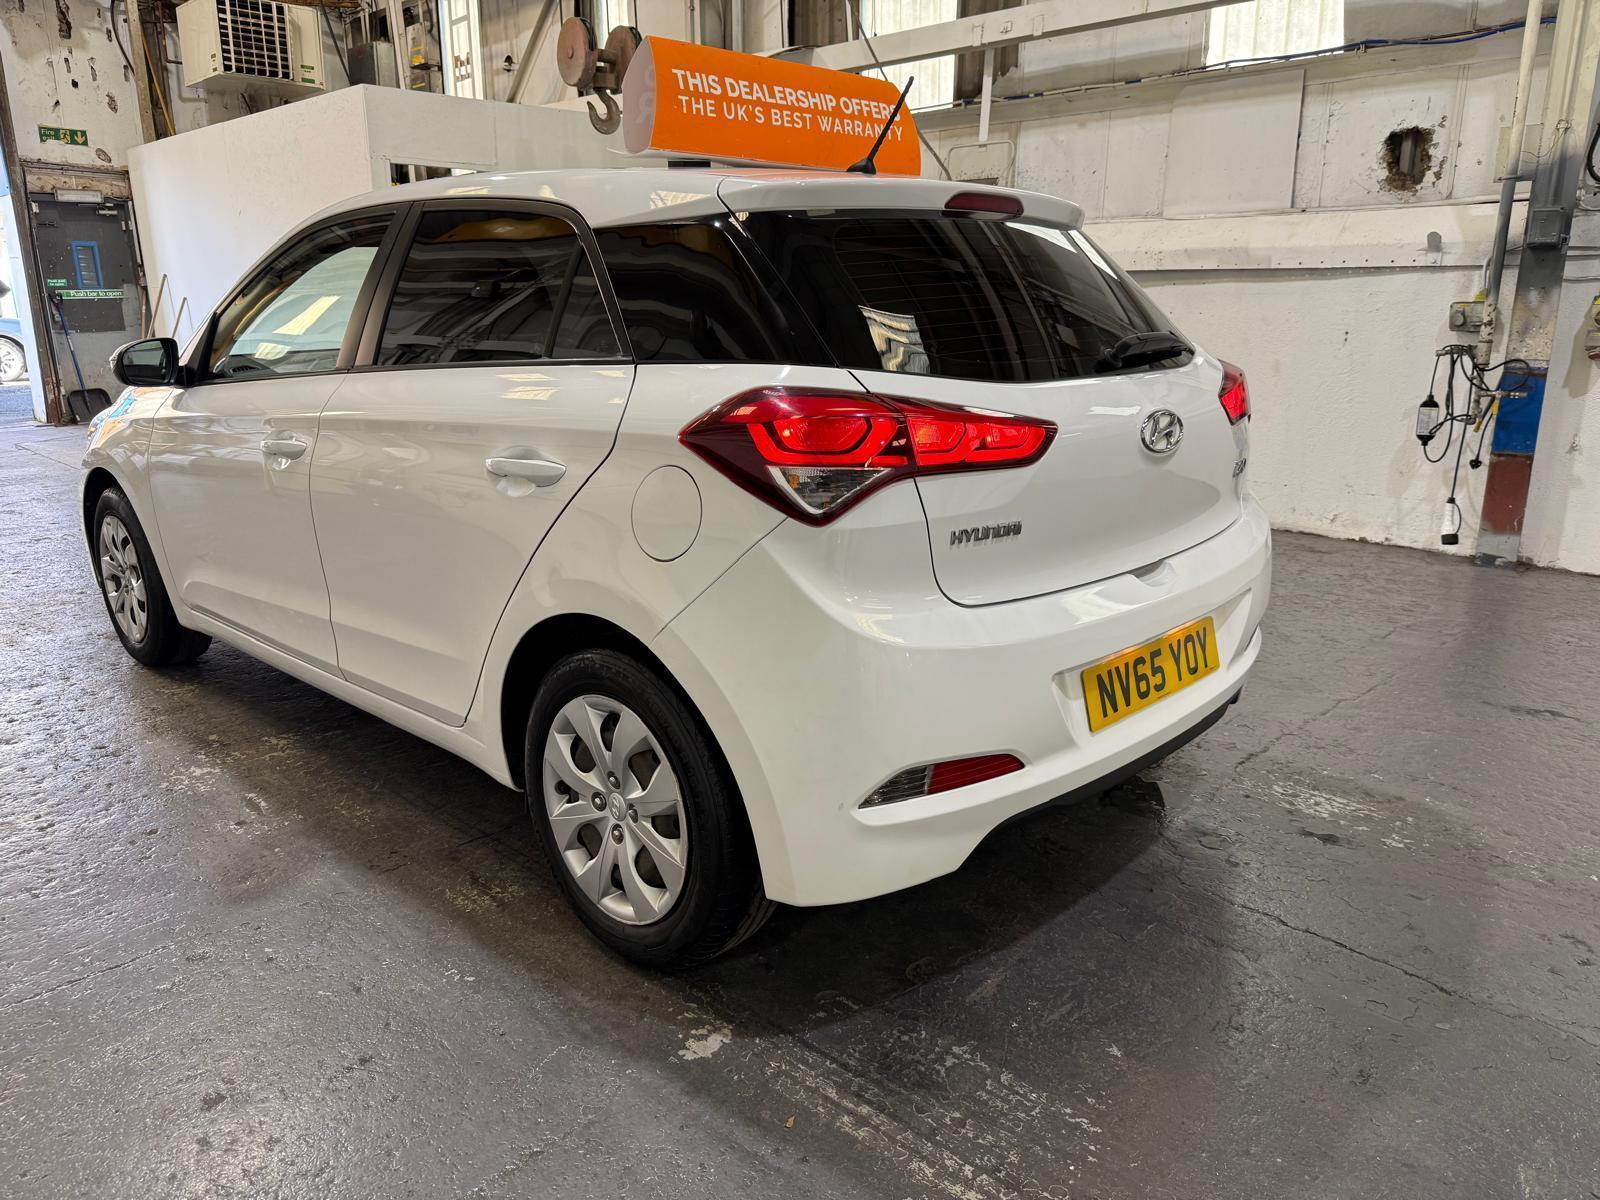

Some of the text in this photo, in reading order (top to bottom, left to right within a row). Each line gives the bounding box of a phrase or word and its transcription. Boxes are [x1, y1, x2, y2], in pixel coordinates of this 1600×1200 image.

[671, 68, 722, 96] THIS
[724, 77, 837, 111] DEALERSHIP
[41, 128, 55, 136] Fire
[678, 95, 903, 141] THE UK'S BEST WARRANTY
[106, 290, 122, 298] open
[950, 521, 1022, 546] HYUNDAI
[1096, 627, 1208, 718] NV65 YOY
